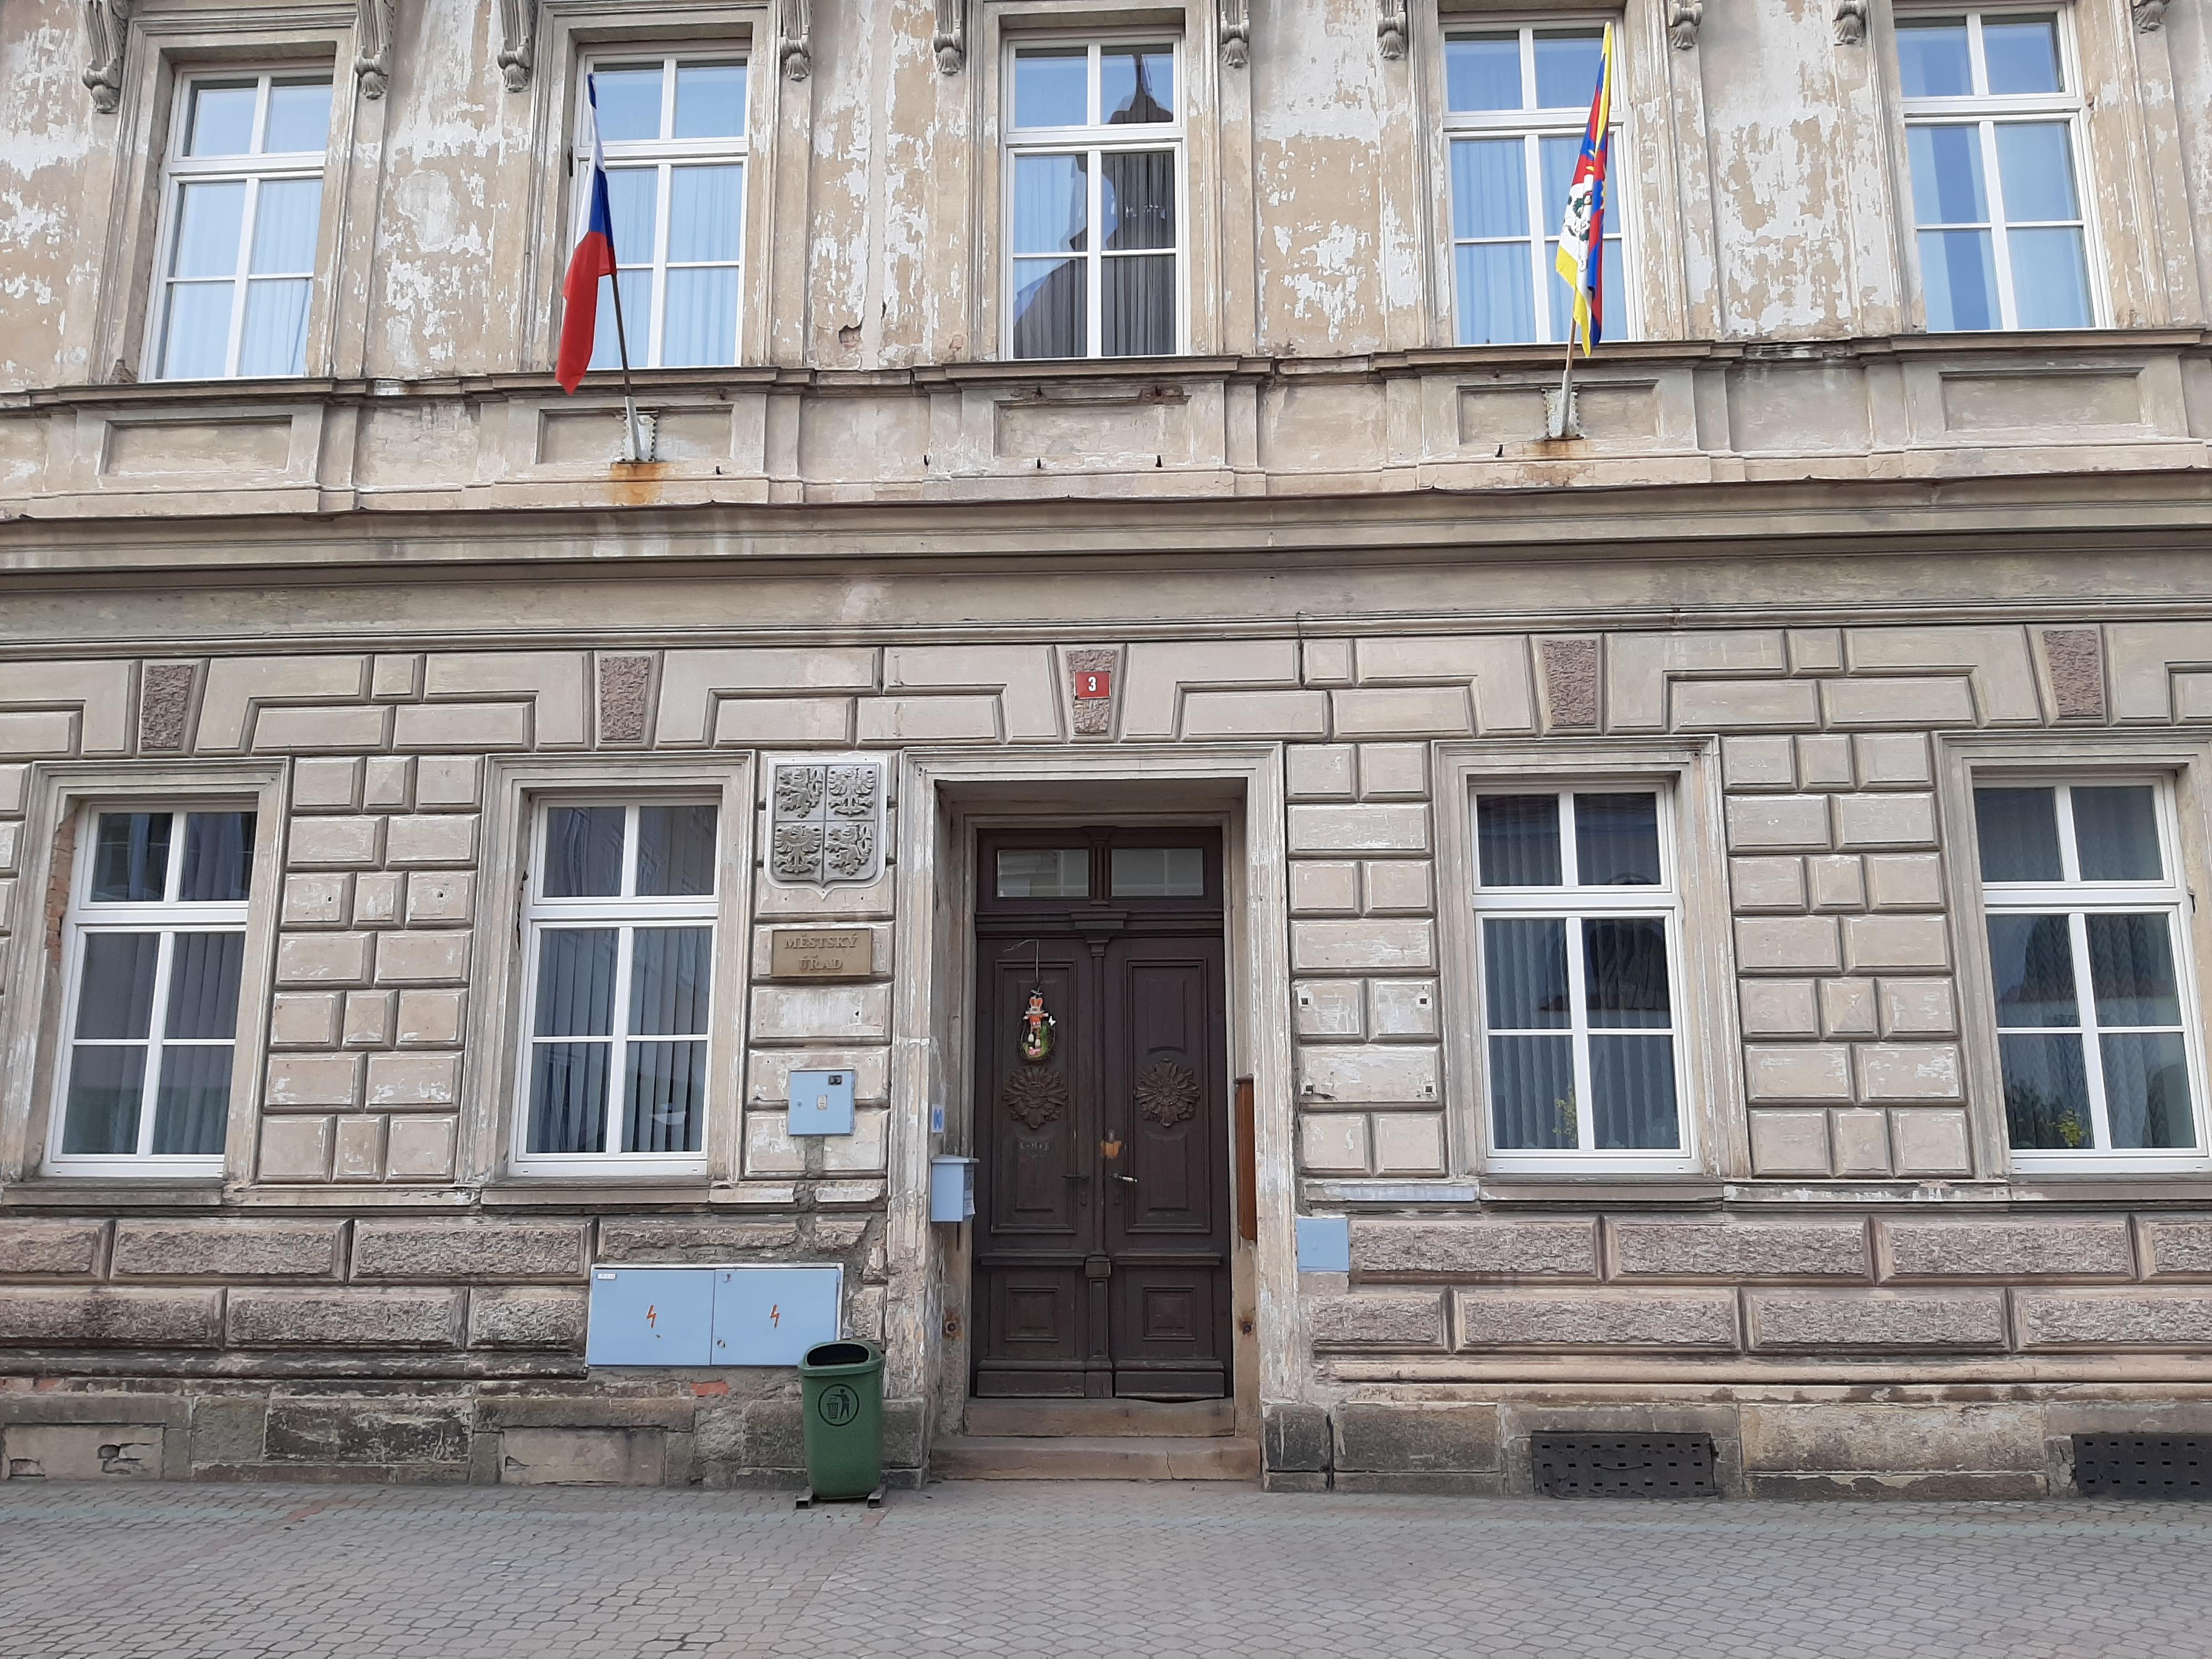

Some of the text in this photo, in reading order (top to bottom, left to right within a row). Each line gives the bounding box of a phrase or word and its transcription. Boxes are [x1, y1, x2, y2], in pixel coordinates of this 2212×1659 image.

[1088, 676, 1097, 692] 3
[785, 932, 858, 949] MĚSTSKÝ
[799, 954, 844, 971] ÚŘAD
